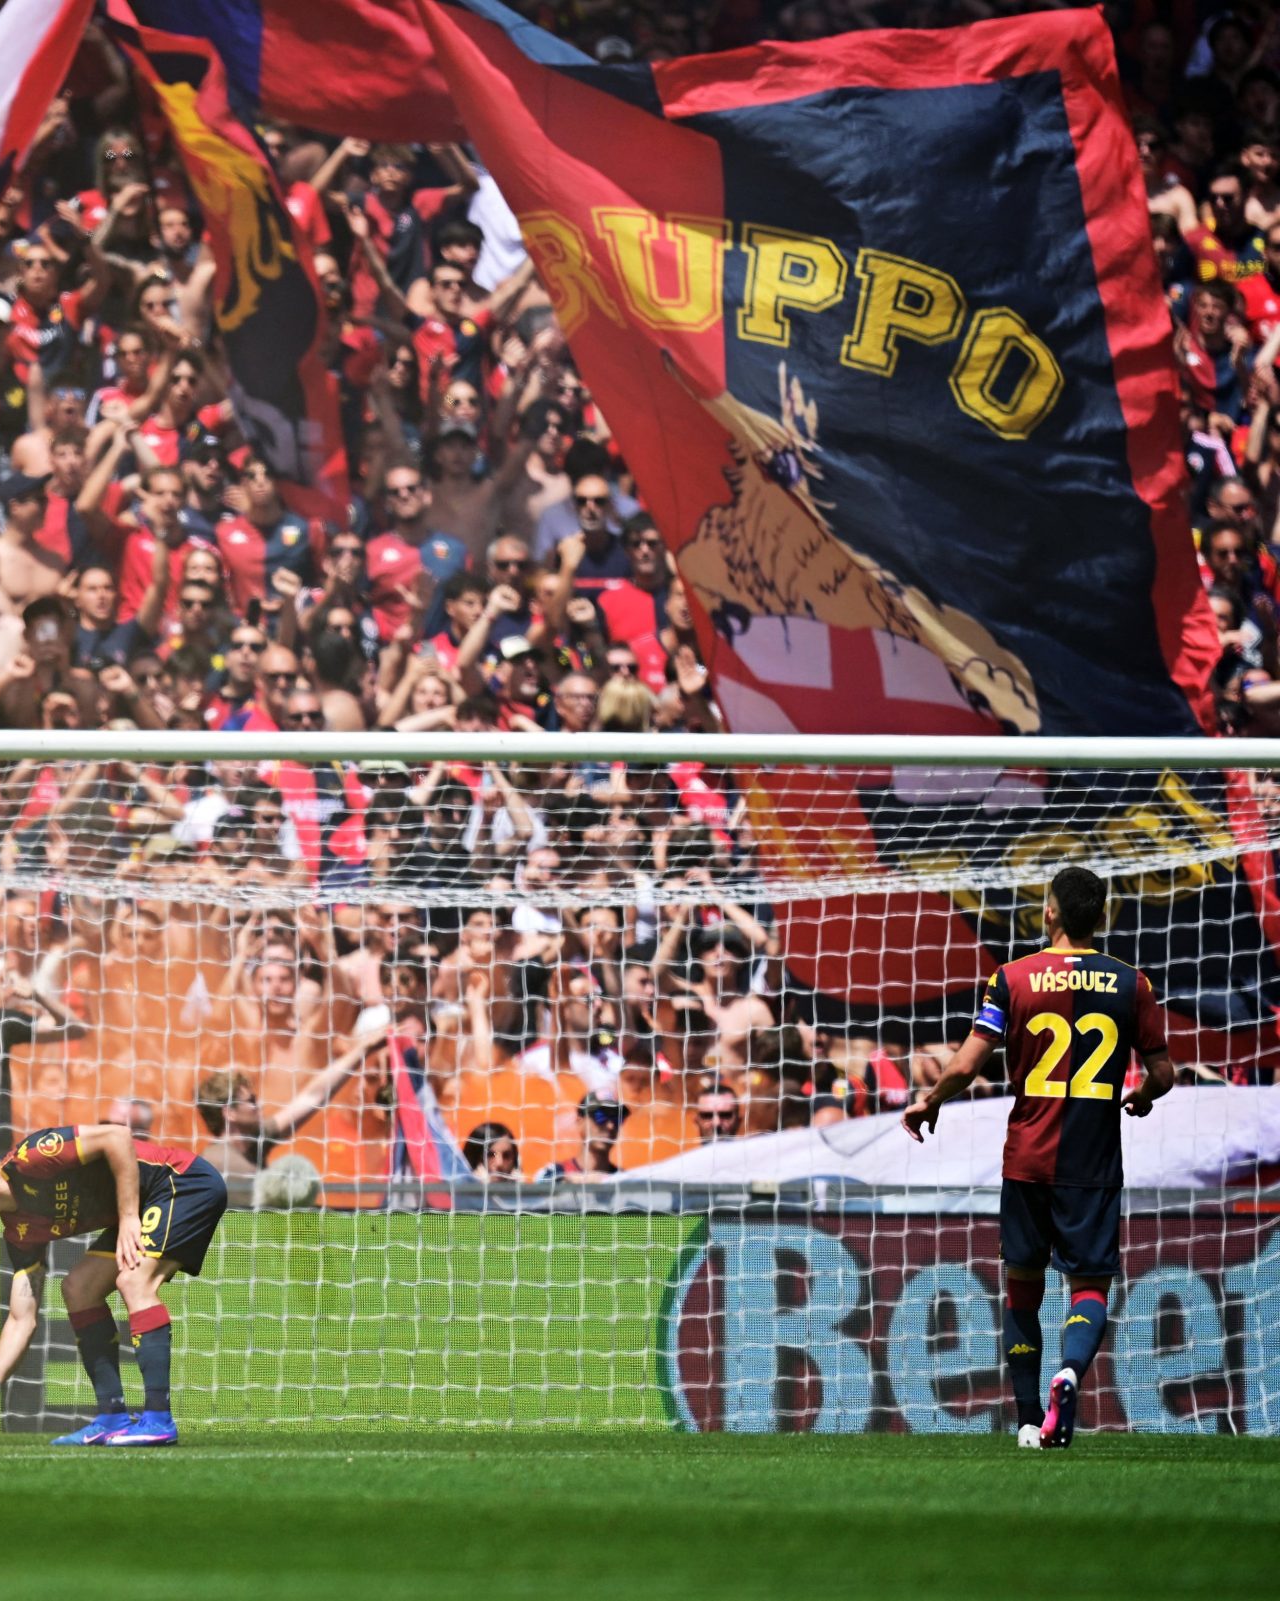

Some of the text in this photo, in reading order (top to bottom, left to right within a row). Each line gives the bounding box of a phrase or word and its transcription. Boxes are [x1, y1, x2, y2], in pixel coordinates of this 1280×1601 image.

[517, 206, 1065, 440] RUPPO
[1028, 966, 1118, 994] VÁSQUEZ
[1024, 1011, 1119, 1101] 22
[141, 1205, 163, 1234] 9
